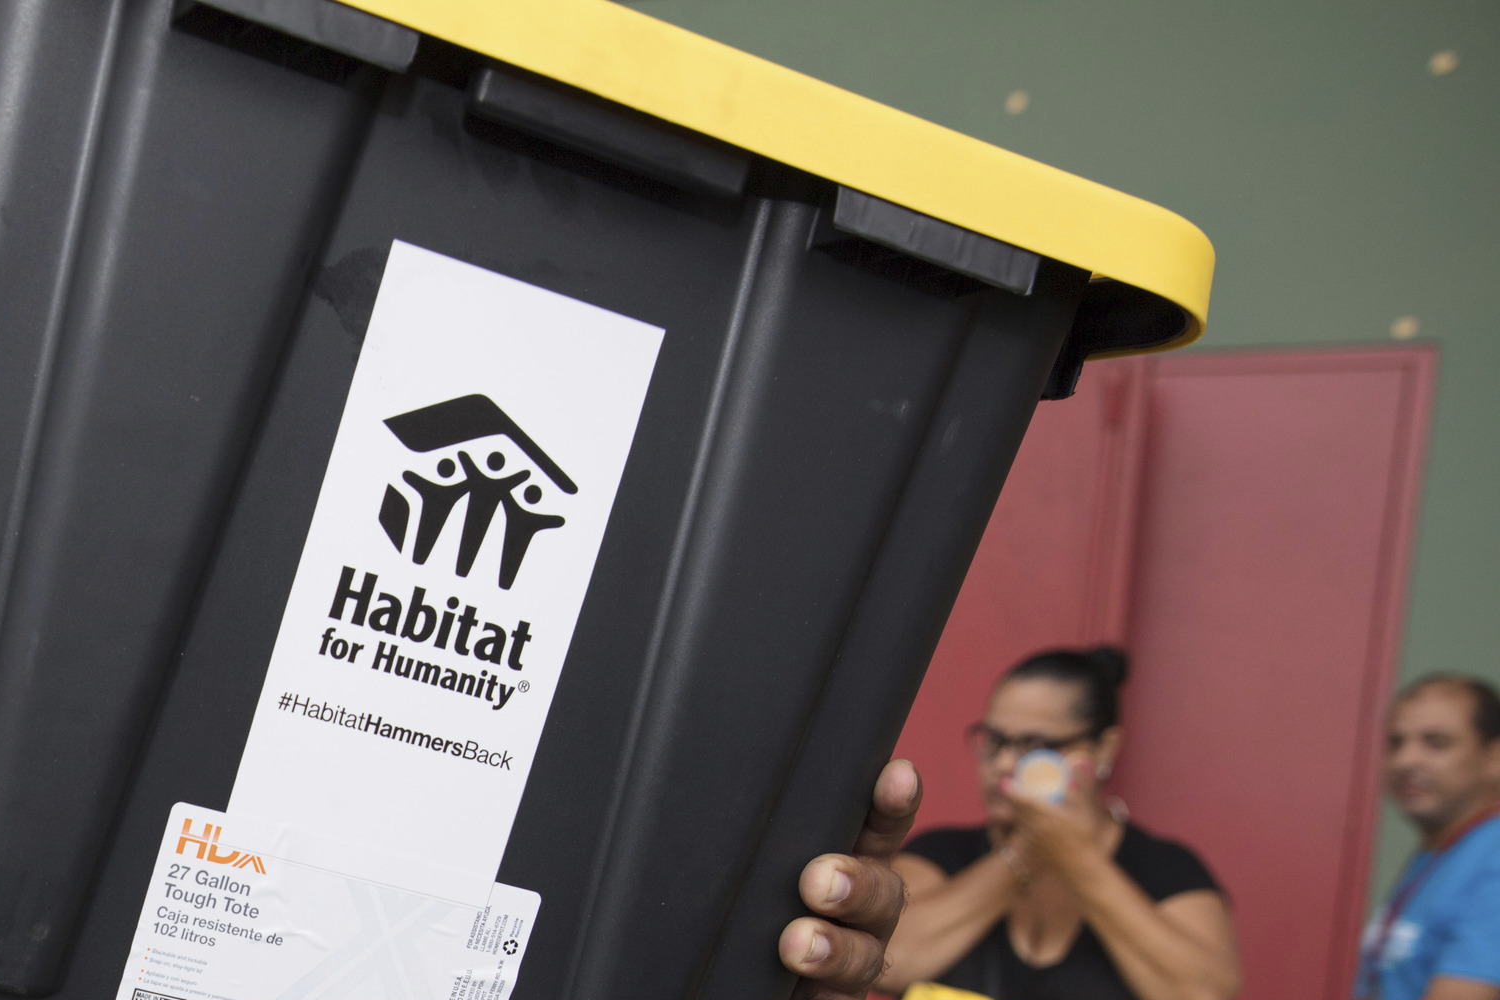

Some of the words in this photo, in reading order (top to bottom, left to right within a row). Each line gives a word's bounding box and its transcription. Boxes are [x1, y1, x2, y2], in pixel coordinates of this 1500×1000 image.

[328, 565, 533, 672] Habitat
[318, 627, 365, 664] for
[278, 691, 513, 771] #HabitatHammersBack
[167, 863, 191, 881] 27
[195, 870, 251, 897] Gallon
[164, 882, 217, 909] Tough
[224, 896, 260, 919] Tote
[153, 922, 178, 938] 102
[180, 928, 216, 947] litros
[156, 906, 189, 924] Caja
[192, 916, 262, 942] resistente
[266, 933, 284, 946] de
[136, 991, 152, 1000] MADE
